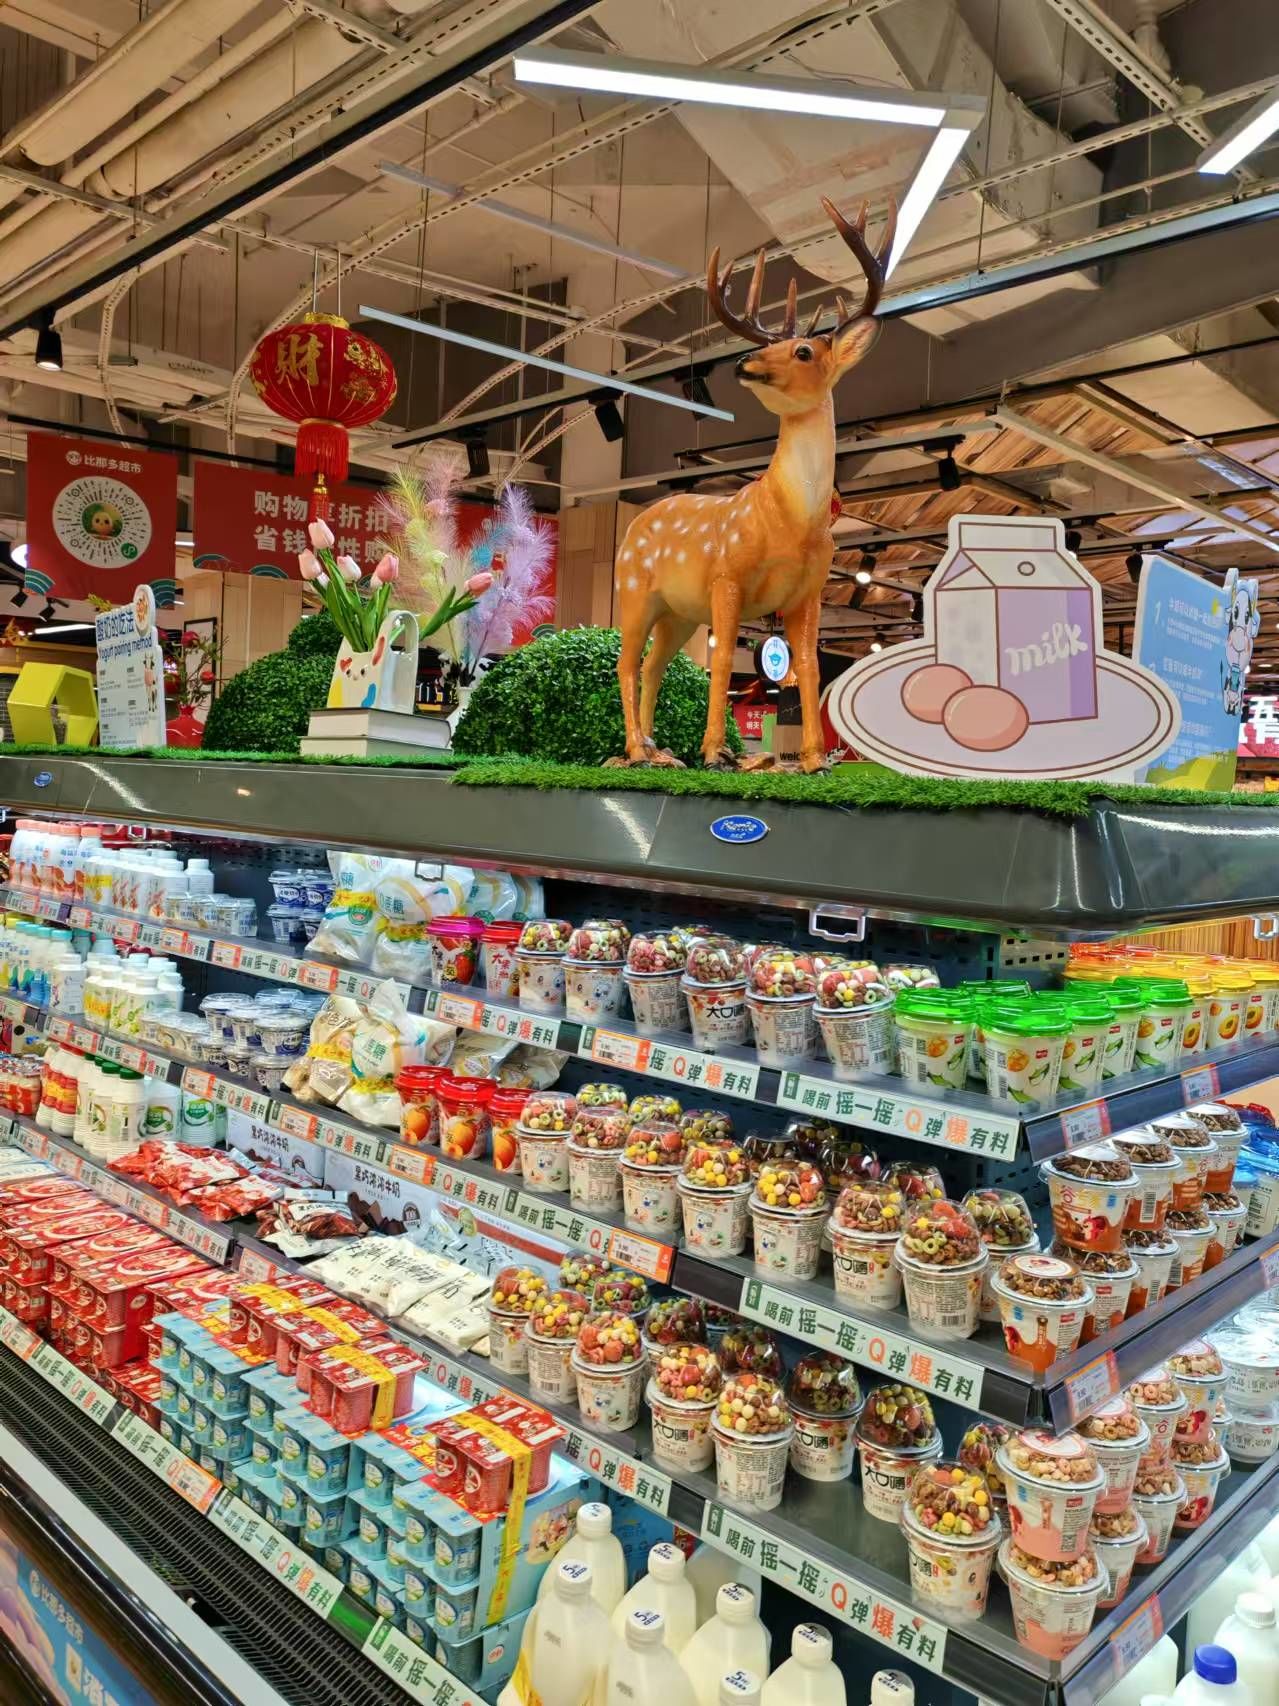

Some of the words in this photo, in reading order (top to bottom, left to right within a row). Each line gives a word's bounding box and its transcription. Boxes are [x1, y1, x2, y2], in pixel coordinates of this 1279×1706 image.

[1004, 622, 1089, 676] milk
[673, 1055, 752, 1094] Q弹爆有料
[802, 1088, 896, 1127] 喝前摇一摇
[904, 1108, 1010, 1154] Q弹爆有料
[443, 1173, 499, 1210] Q弹爆有料
[519, 1204, 585, 1243] 喝前摇一摇
[764, 1300, 859, 1353] 喝前摇一摇
[868, 1337, 973, 1401] Q弹爆有料
[589, 1448, 664, 1507] Q弹爆有料
[276, 1551, 334, 1610] Q弹爆有料
[725, 1528, 821, 1595] 喝前摇一摇
[831, 1582, 937, 1662] Q弹爆有料
